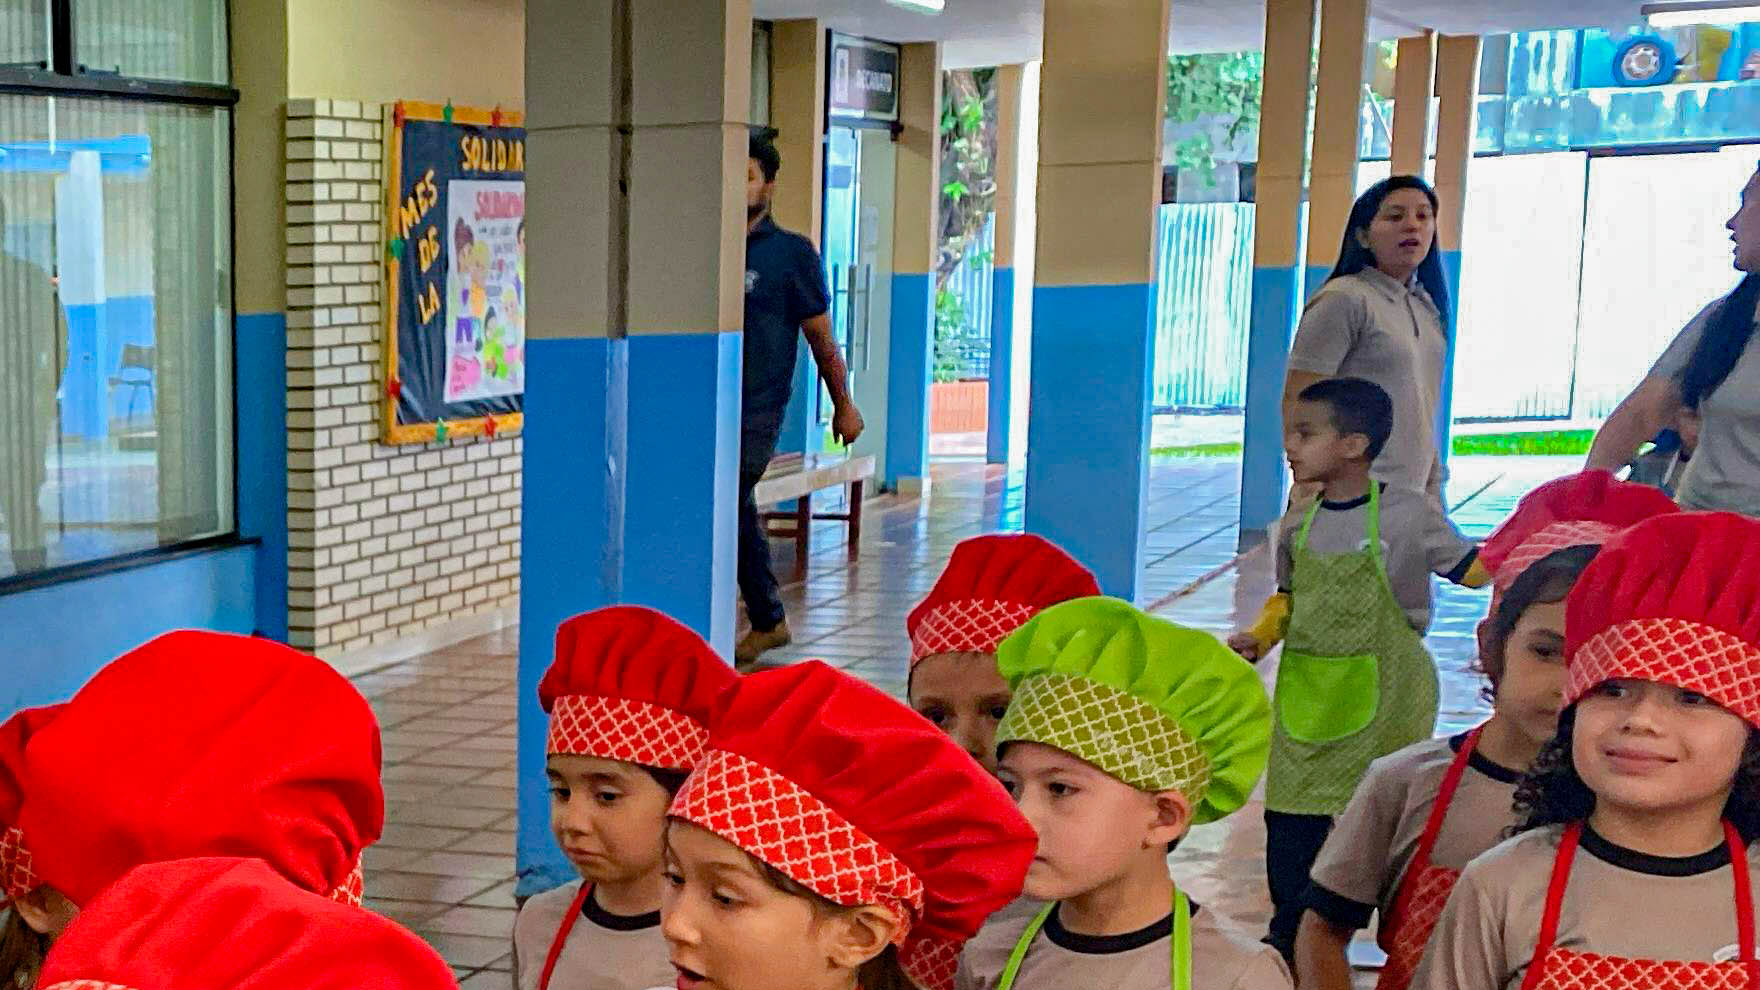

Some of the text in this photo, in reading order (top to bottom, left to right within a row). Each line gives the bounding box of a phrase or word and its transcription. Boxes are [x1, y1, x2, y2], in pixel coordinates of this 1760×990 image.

[400, 169, 438, 239] MES
[419, 225, 440, 273] DE
[418, 280, 440, 325] LA
